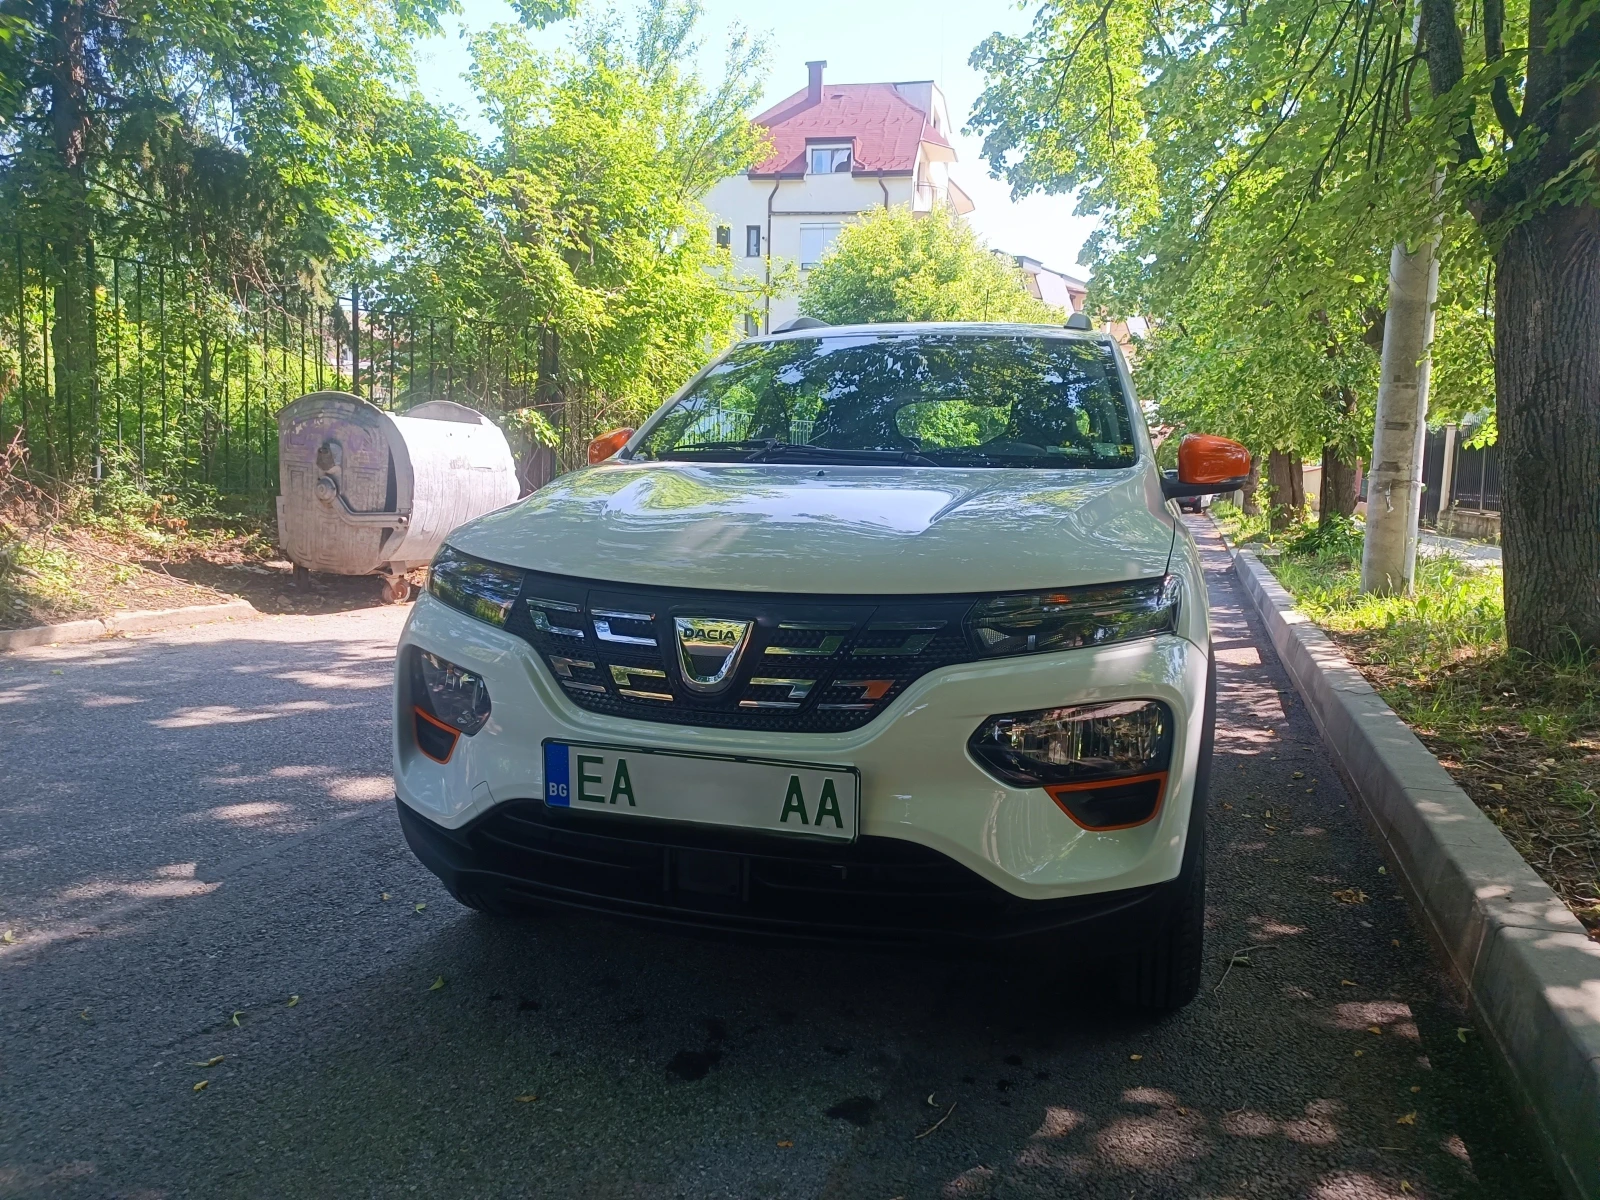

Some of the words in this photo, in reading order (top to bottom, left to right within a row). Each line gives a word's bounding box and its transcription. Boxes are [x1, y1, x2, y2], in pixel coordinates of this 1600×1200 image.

[683, 628, 736, 641] DACIA
[549, 782, 568, 797] BG
[577, 754, 636, 807] EA
[779, 774, 844, 829] AA
